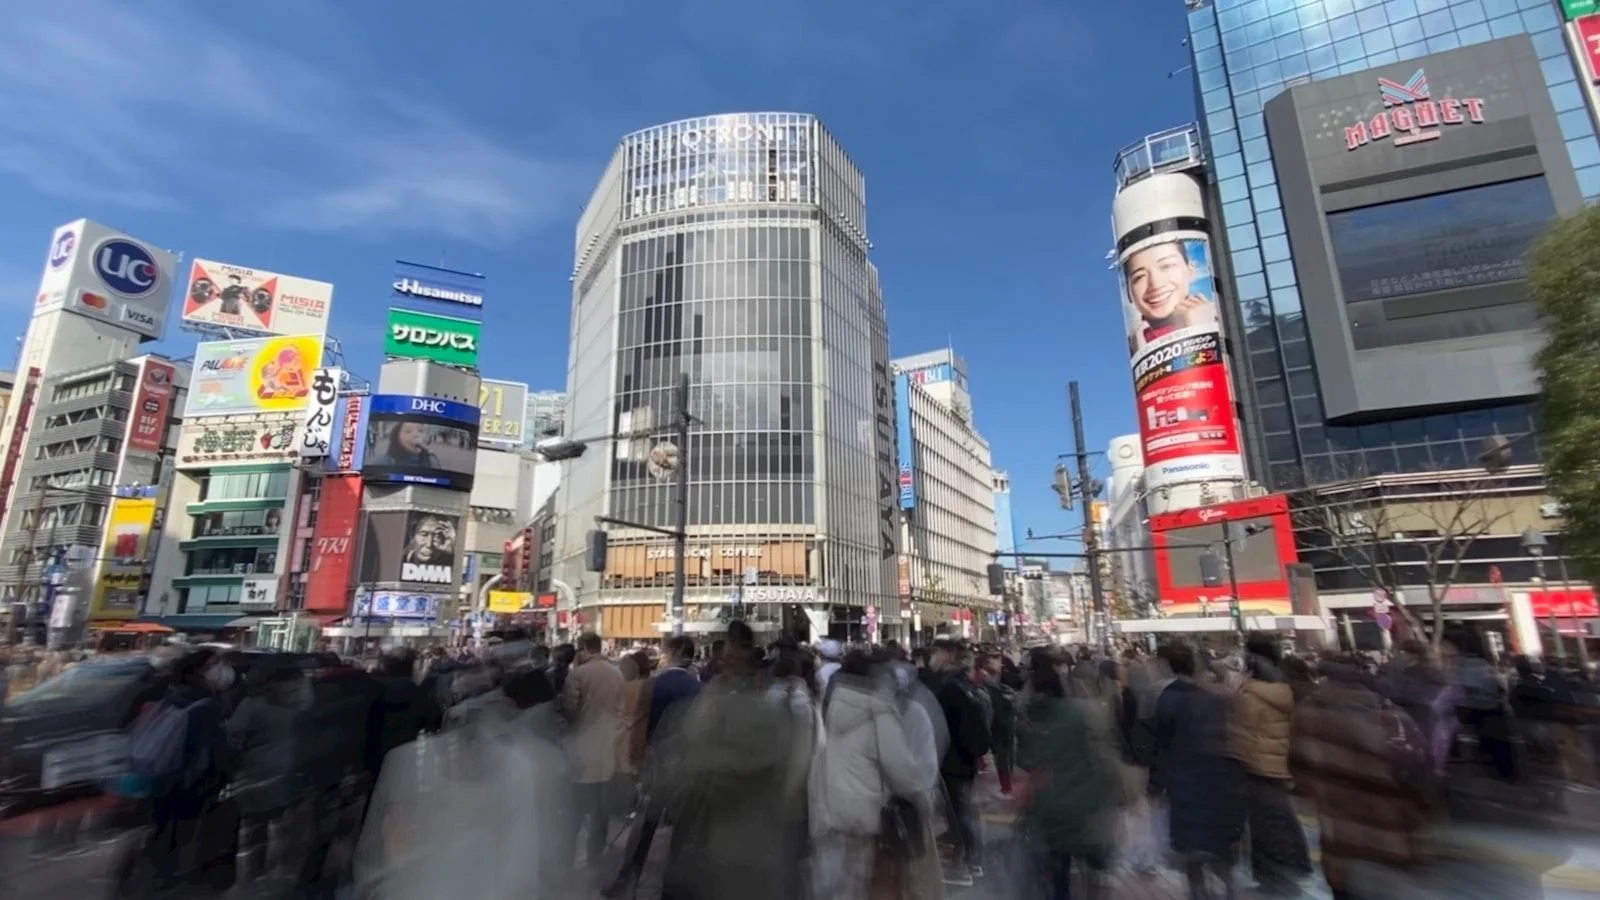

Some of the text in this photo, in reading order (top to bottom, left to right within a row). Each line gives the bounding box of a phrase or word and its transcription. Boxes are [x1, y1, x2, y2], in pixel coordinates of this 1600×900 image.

[1344, 98, 1485, 150] MAGNET
[393, 278, 482, 305] Hisamitsu
[126, 309, 154, 325] VISA
[391, 323, 475, 350] サロンパス
[303, 368, 336, 453] もんじゃ
[411, 399, 446, 413] DHC
[875, 360, 895, 560] TSUTAYA
[1162, 463, 1209, 474] Panasonic
[402, 562, 452, 583] DMM
[748, 588, 815, 601] TSUTAYA
